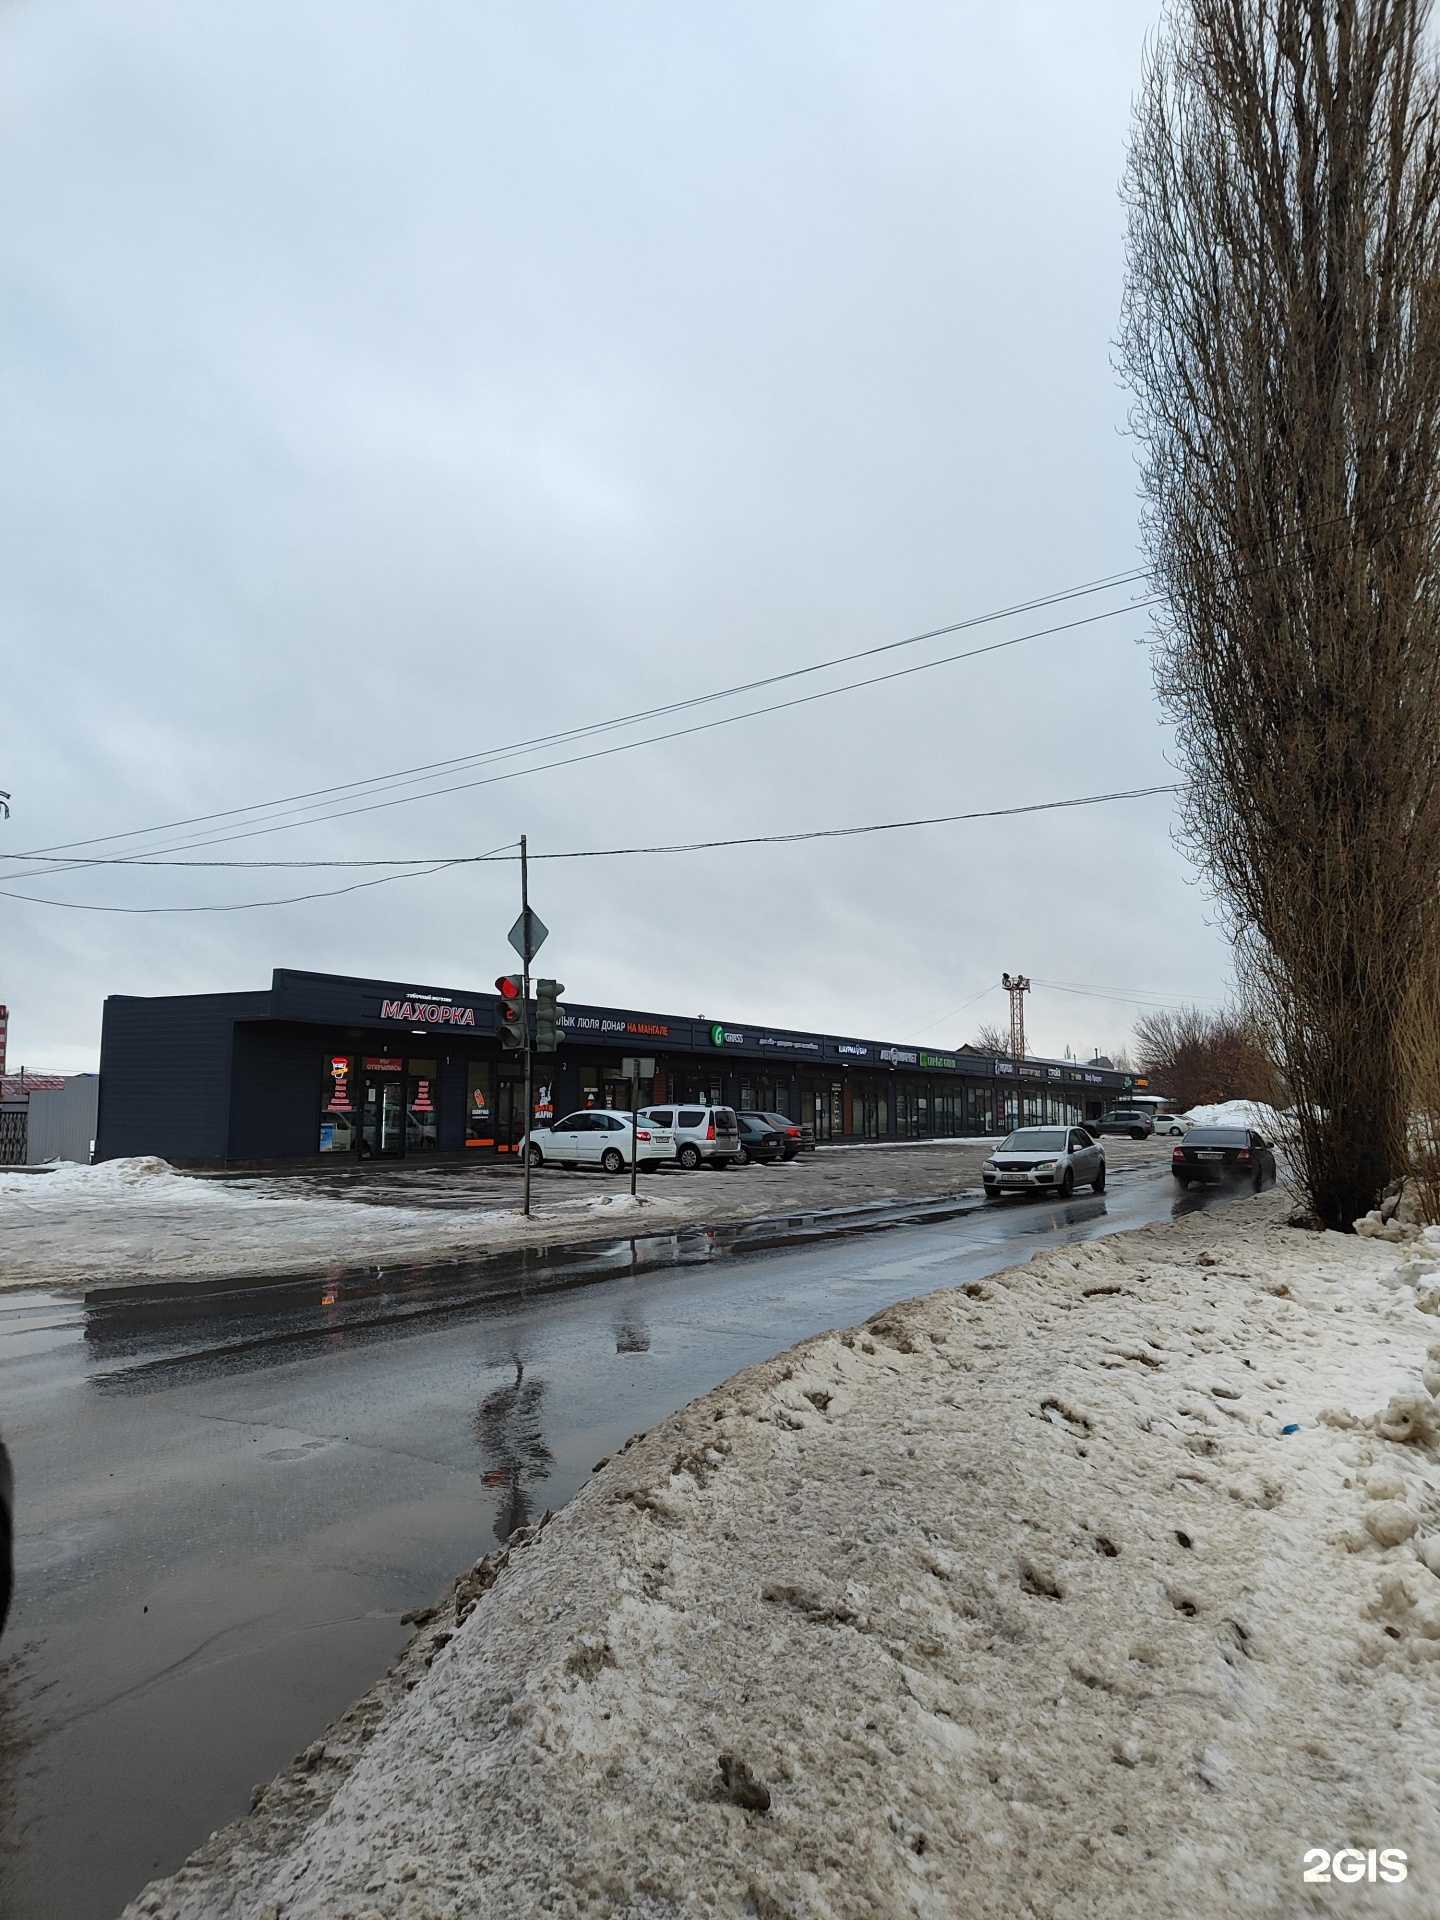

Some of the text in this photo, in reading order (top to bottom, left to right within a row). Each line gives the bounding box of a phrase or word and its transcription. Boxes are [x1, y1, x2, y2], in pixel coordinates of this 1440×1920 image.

[380, 1000, 476, 1026] МАХОРКА
[577, 1018, 600, 1029] ЛЮЛЯ
[601, 1020, 626, 1032] ДОНАР
[627, 1023, 638, 1033] НА
[638, 1024, 669, 1036] МАНГАЛЕ
